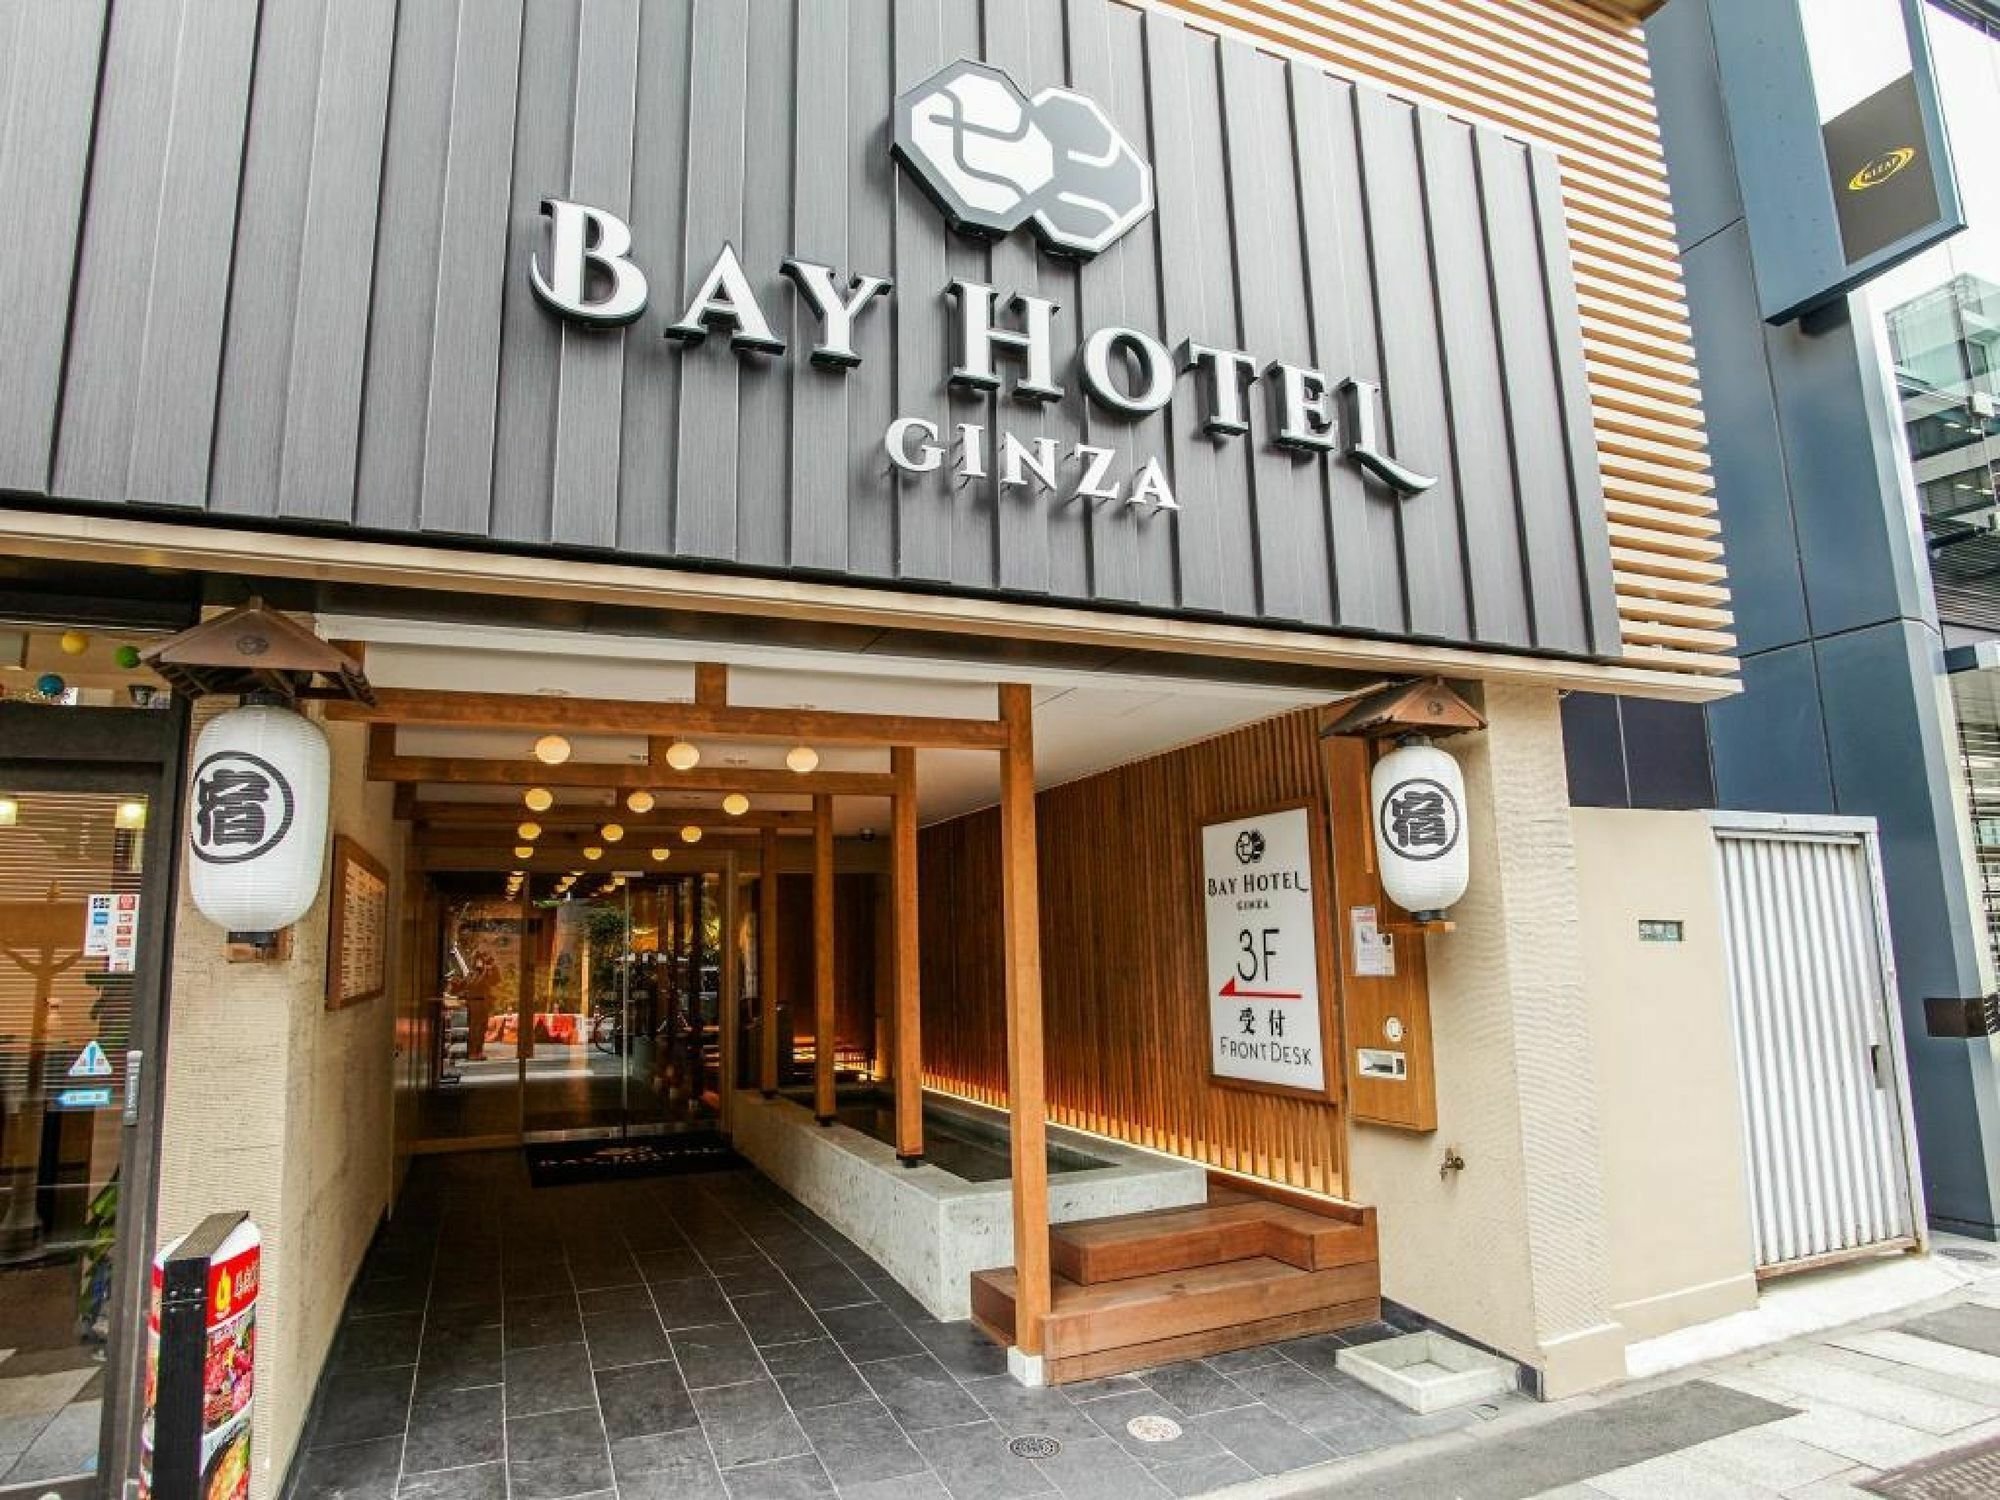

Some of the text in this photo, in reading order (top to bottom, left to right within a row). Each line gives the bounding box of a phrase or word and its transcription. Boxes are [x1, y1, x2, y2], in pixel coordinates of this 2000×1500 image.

[530, 199, 1438, 496] BAY HOTEL
[884, 417, 1180, 511] GINZA
[1208, 870, 1310, 897] BAY HOTEL
[1237, 928, 1280, 982] 3F
[1239, 1006, 1286, 1037] 受付
[1220, 1036, 1312, 1066] FRONT DESK
